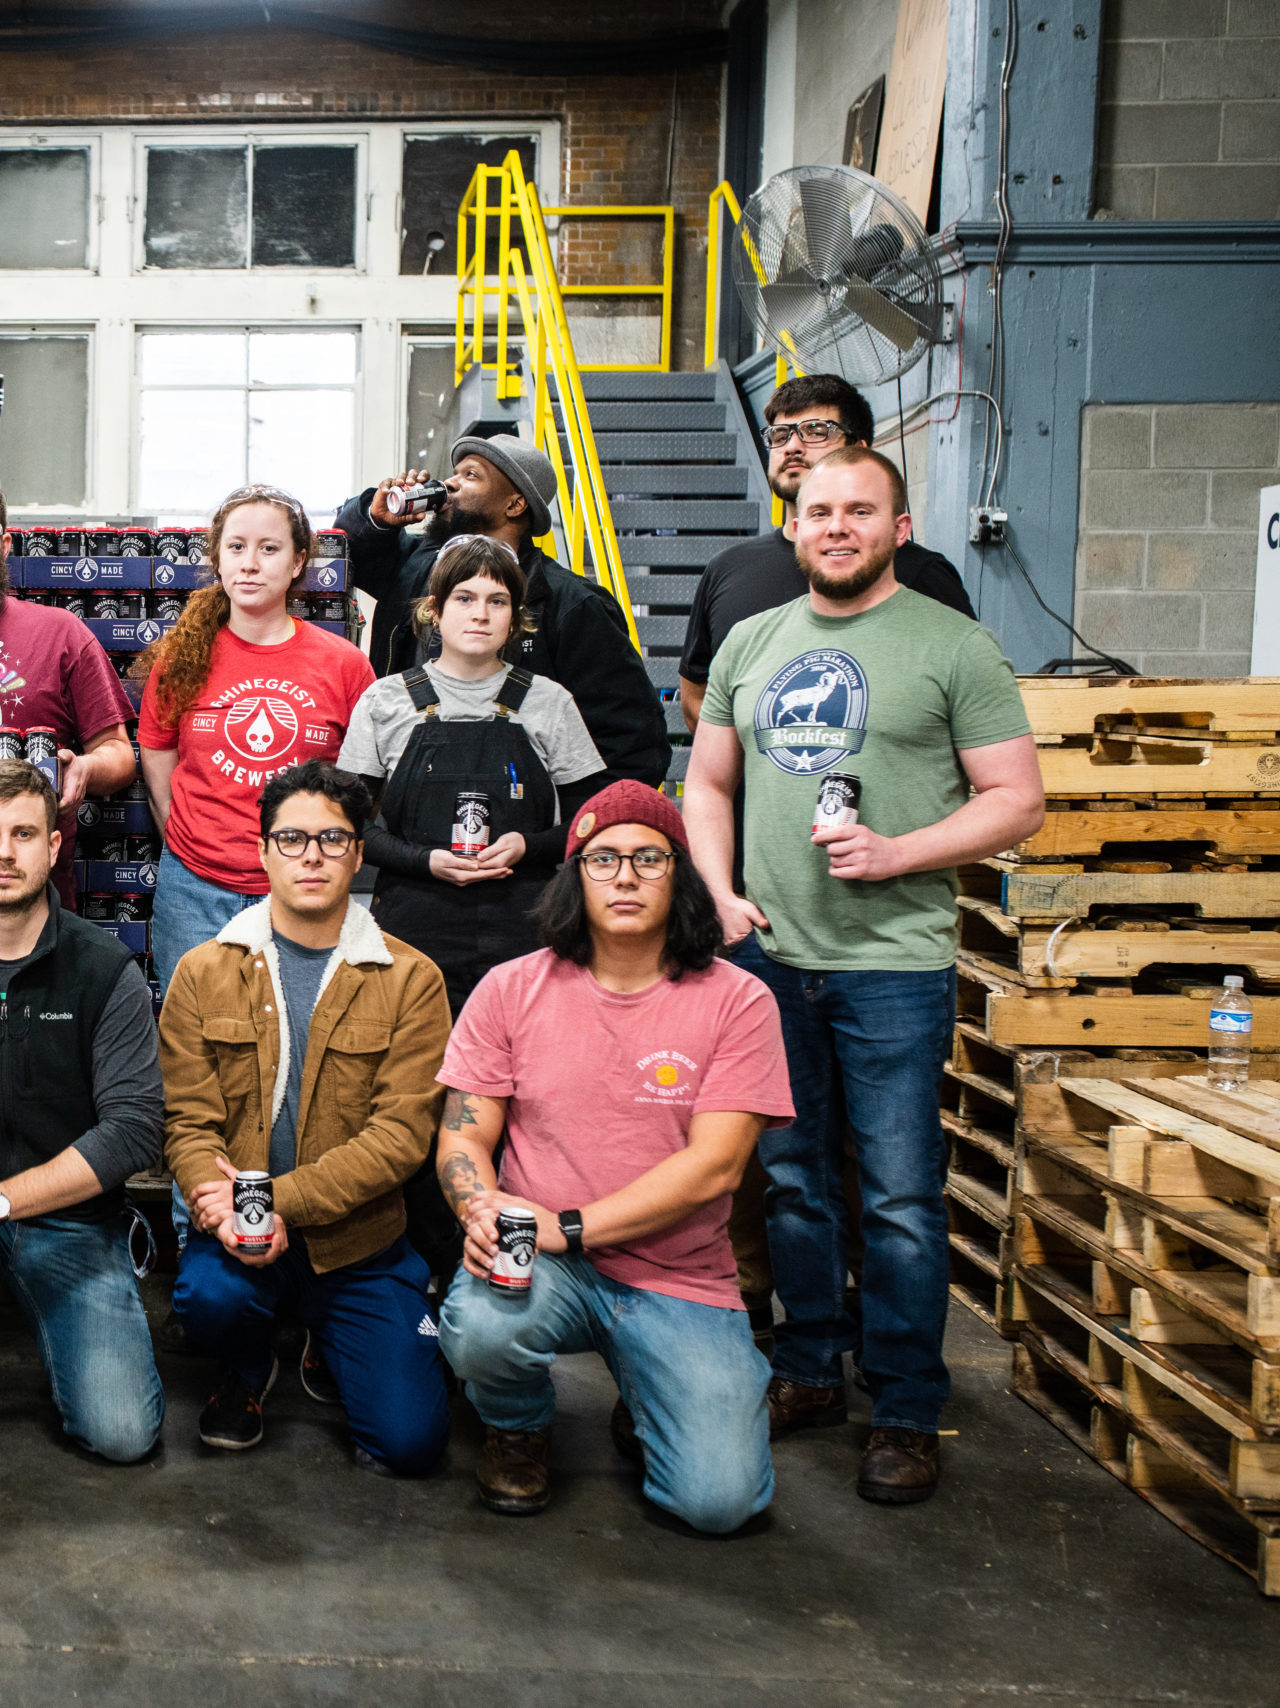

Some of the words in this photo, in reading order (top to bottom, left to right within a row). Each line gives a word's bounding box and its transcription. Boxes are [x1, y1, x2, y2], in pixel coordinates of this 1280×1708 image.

[51, 566, 73, 574] CINCY
[101, 566, 123, 574] MADE
[113, 628, 135, 637] CINCY
[771, 663, 803, 689] FLYING
[804, 656, 821, 665] PIG
[822, 655, 859, 688] MARATHON
[192, 717, 217, 728] CINCY
[304, 729, 330, 741] MADE
[770, 728, 848, 746] Bockfest
[104, 811, 125, 820] MADE
[115, 871, 137, 879] CINCY
[636, 1050, 670, 1070] DRINK
[671, 1050, 698, 1071] BEER
[642, 1081, 658, 1093] BE
[657, 1082, 691, 1096] HAPPY
[502, 1229, 536, 1244] RHINEGE
